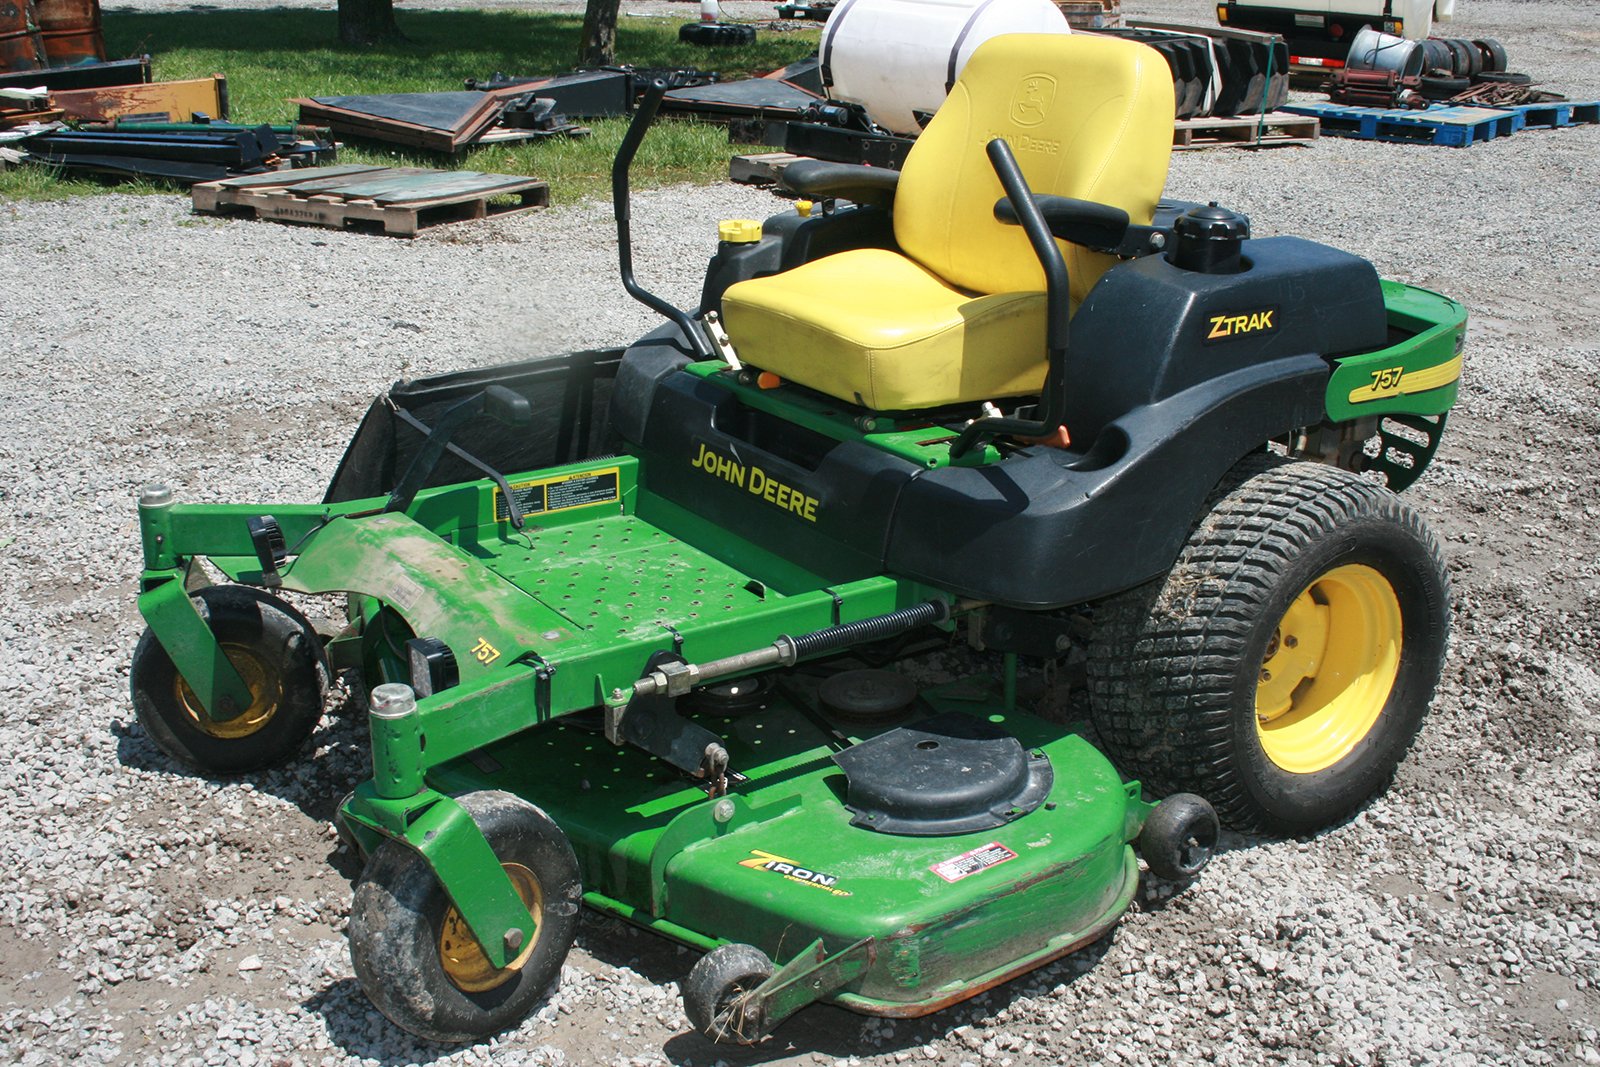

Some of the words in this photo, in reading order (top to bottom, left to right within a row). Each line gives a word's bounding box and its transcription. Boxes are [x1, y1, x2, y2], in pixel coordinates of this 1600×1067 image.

[1018, 133, 1061, 155] DEERE
[1207, 310, 1274, 339] ZTRAK
[1371, 366, 1404, 392] 757
[692, 443, 746, 488] JOHN
[748, 465, 820, 523] DEERE
[470, 637, 501, 666] 757
